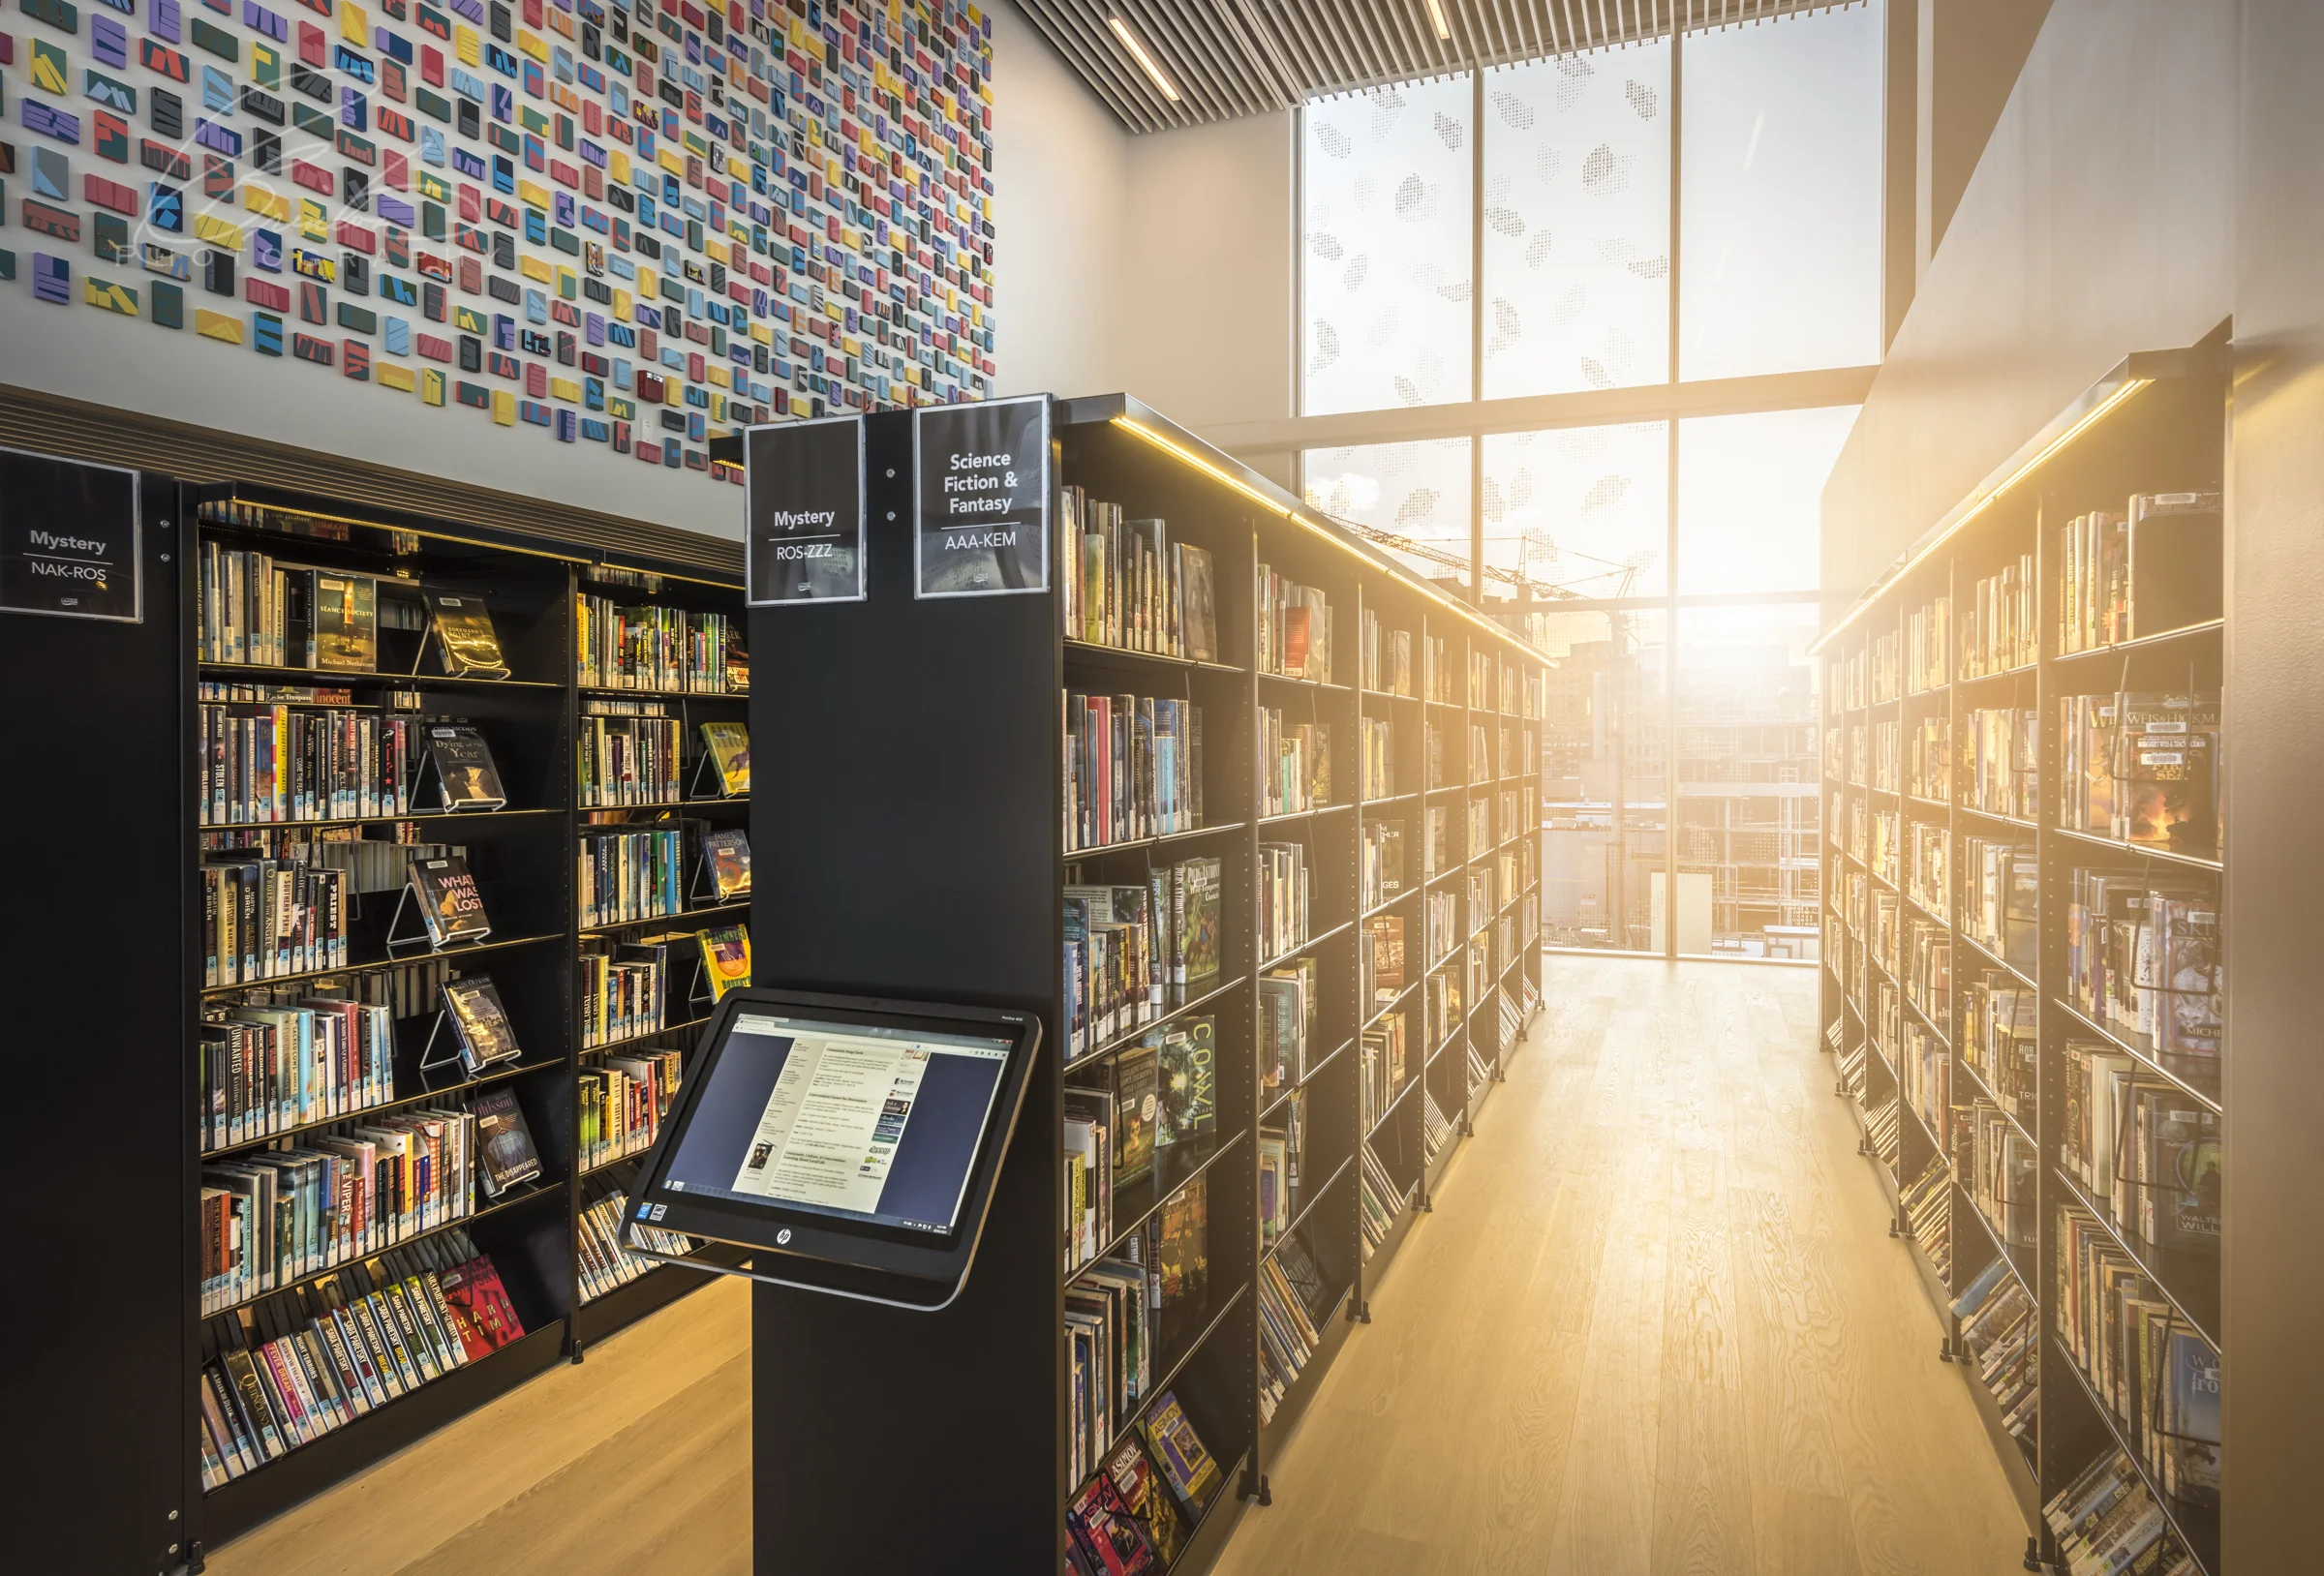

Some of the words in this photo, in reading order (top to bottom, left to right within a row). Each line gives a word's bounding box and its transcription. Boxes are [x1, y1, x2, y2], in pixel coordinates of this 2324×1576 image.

[950, 453, 1011, 470] Science
[944, 476, 998, 493] Fiction
[1004, 471, 1018, 488] &
[950, 497, 1013, 516] Fantasy
[774, 509, 836, 530] Mystery
[30, 530, 107, 556] Mystery
[777, 543, 833, 561] ROS-ZZZ
[945, 531, 1016, 550] AAA-KEM
[31, 561, 107, 581] NAK-ROS
[285, 691, 312, 702] Trespass
[436, 740, 464, 749] Dying
[450, 747, 478, 759] Year
[215, 765, 225, 786] STOLEN
[709, 839, 746, 848] PATTERSON
[714, 833, 735, 841] JAMES
[438, 874, 474, 889] WHAT
[226, 891, 235, 925] CONFESSION
[455, 897, 483, 912] LOST
[704, 929, 748, 945] PLAYMATES
[231, 1028, 242, 1074] UNWANTED
[1192, 1022, 1213, 1131] COWL
[495, 1169, 505, 1182] THE
[504, 1158, 538, 1177] DISAPPEARED
[341, 1181, 352, 1212] VIPER
[779, 1228, 790, 1245] hp
[378, 1306, 387, 1320] SARA
[392, 1295, 402, 1311] SARA
[397, 1308, 413, 1335] PARETSKY
[411, 1287, 421, 1302] SARA
[416, 1299, 433, 1325] PARETSKY
[456, 1298, 509, 1330] HARD
[360, 1313, 370, 1329] SARA
[365, 1326, 382, 1354] PARETSKY
[382, 1318, 400, 1346] PARETSKY
[462, 1311, 515, 1342] TIME
[325, 1327, 335, 1346] SARA
[331, 1342, 351, 1372] PARETSKY
[344, 1320, 353, 1336] SARA
[350, 1334, 368, 1363] PARETSKY
[268, 1346, 282, 1369] FEVER
[278, 1368, 292, 1392] DREAM
[281, 1342, 294, 1366] MIRROR
[290, 1366, 303, 1388] IMAGE
[295, 1336, 306, 1353] NIGHT
[302, 1352, 318, 1379] TERRORS
[1112, 1442, 1138, 1475] ASIMOV
